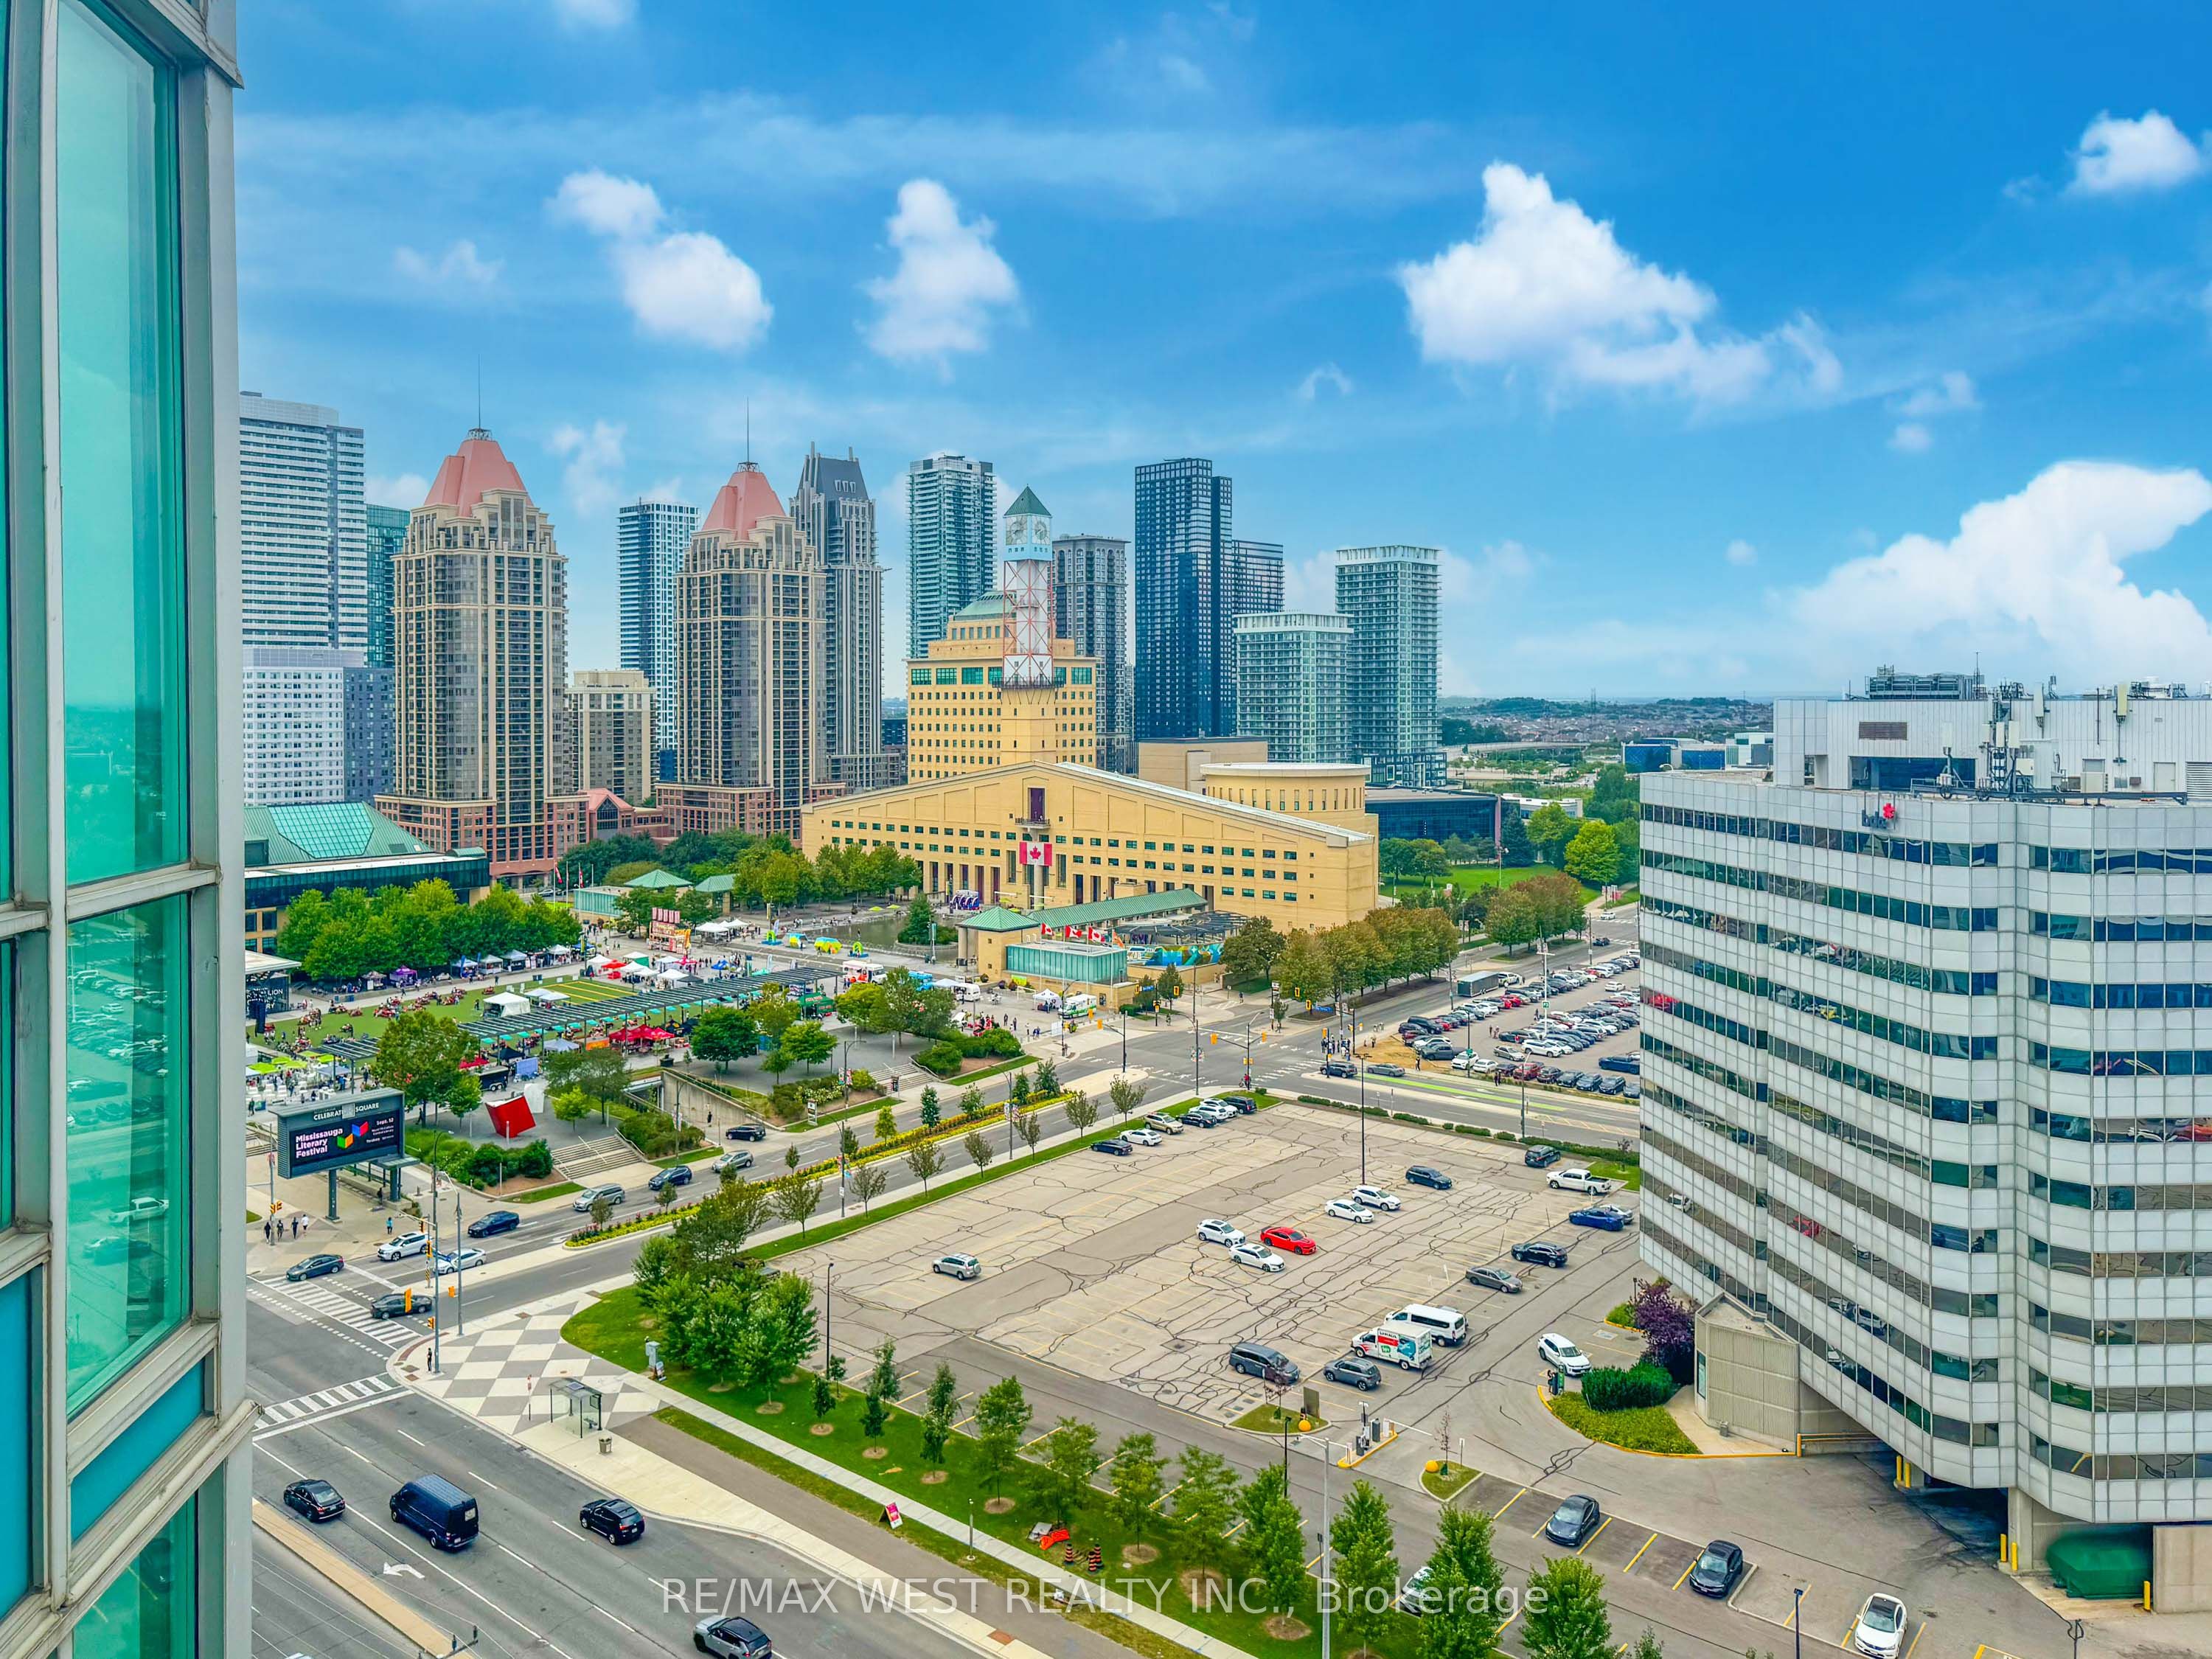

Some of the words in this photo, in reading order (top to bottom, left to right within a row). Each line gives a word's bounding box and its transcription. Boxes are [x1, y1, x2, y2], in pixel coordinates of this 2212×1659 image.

[355, 1102, 380, 1113] SQUARE
[296, 1127, 344, 1143] Mississauga
[296, 1138, 328, 1151] Literary
[296, 1145, 328, 1159] Festival
